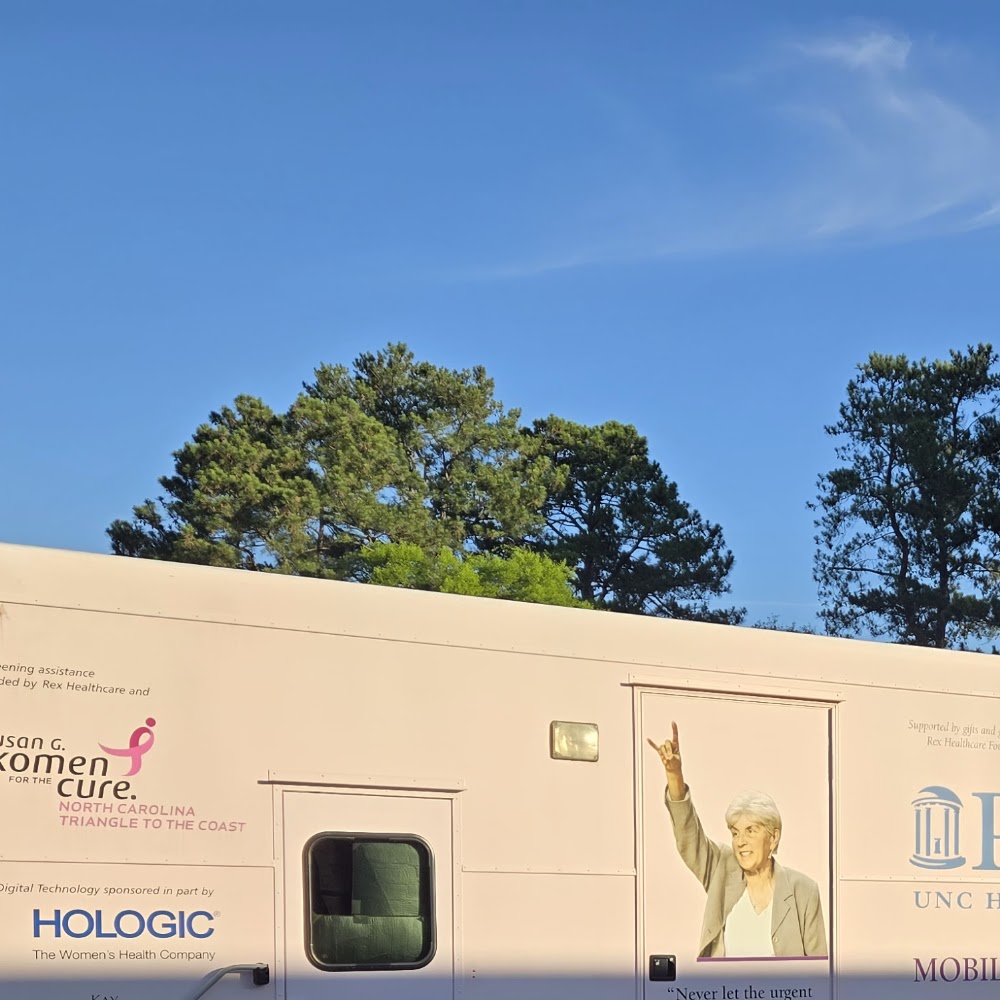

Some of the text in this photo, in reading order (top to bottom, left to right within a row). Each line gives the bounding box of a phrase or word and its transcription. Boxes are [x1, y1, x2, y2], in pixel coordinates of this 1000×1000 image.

[38, 666, 95, 678] assistance
[23, 678, 37, 690] by
[42, 680, 63, 690] Rex
[66, 681, 126, 695] Healthcare
[129, 687, 150, 696] and
[907, 719, 949, 733] Supported
[951, 722, 961, 735] by
[962, 724, 979, 736] gifts
[981, 725, 996, 736] and
[50, 738, 66, 751] G.
[927, 736, 942, 747] Rex
[944, 738, 987, 750] Healthcare
[9, 775, 53, 785] FOR THE
[57, 778, 137, 800] cure.
[59, 801, 196, 817] NORTH CAROLINA
[59, 815, 247, 833] TRIANGLE TO THE COAST
[38, 883, 101, 896] Technology
[103, 885, 160, 896] sponsored
[163, 885, 173, 895] in
[176, 886, 199, 897] part
[201, 886, 215, 897] by
[914, 890, 973, 909] UNC
[32, 949, 216, 963] The Women's Health Company
[722, 985, 740, 1000] let
[744, 985, 765, 999] the
